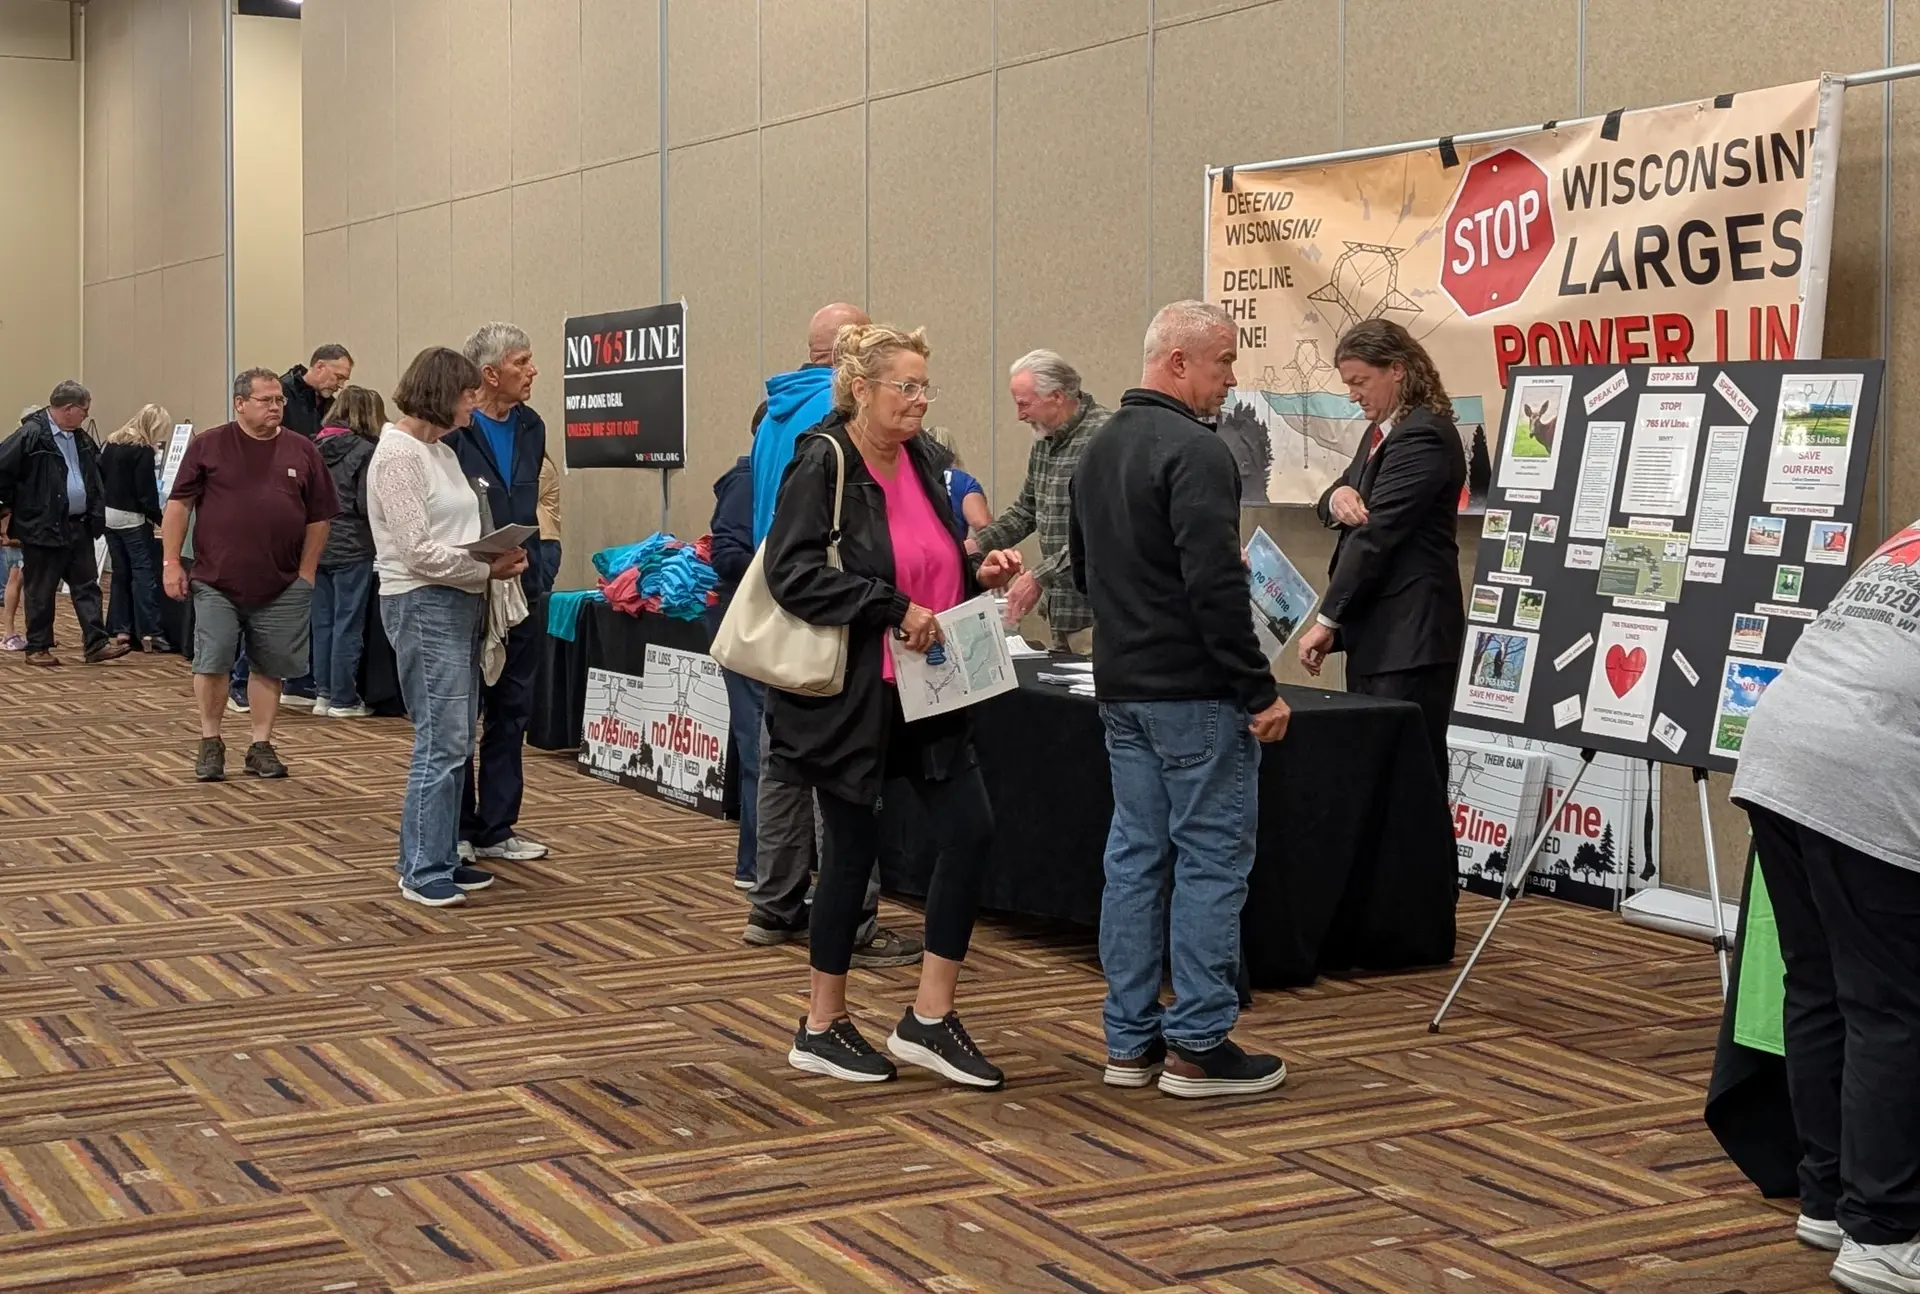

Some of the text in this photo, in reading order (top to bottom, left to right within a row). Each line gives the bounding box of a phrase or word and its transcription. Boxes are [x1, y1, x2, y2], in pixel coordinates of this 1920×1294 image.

[1227, 191, 1294, 216] DEFEND
[1225, 218, 1322, 246] WISCONSIN!
[1451, 188, 1540, 276] STOP
[1558, 208, 1803, 297] LARGES
[1223, 266, 1294, 292] DECLINE
[1221, 298, 1257, 320] THE
[566, 323, 681, 369] NO765LINE
[1239, 326, 1267, 349] NE!
[1493, 312, 1695, 389] POWER
[1650, 371, 1696, 382] STOP 765 KV
[566, 392, 623, 410] NOT A DONE DEAL
[1588, 377, 1626, 408] SPEAK UP!
[1718, 378, 1754, 417] SPEAK OUT!
[1660, 401, 1682, 411] STOP!
[567, 421, 591, 437] UNLESS
[624, 420, 639, 436] OUT
[1646, 419, 1659, 428] 765
[1816, 434, 1841, 444] Lines
[1798, 451, 1821, 460] SAVE
[1782, 465, 1834, 475] OUR FARMS
[1843, 581, 1920, 618] -768-329
[1896, 618, 1918, 633] WI
[646, 649, 671, 667] OUR LOSS
[700, 660, 717, 677] THEIR
[1743, 682, 1755, 691] NO
[1469, 689, 1515, 704] SAVE MY HOME
[662, 753, 700, 777] NO NEED
[1484, 752, 1525, 770] THEIR GAIN
[1453, 801, 1507, 847] 5line
[1457, 844, 1474, 858] EED
[1541, 836, 1561, 855] ED
